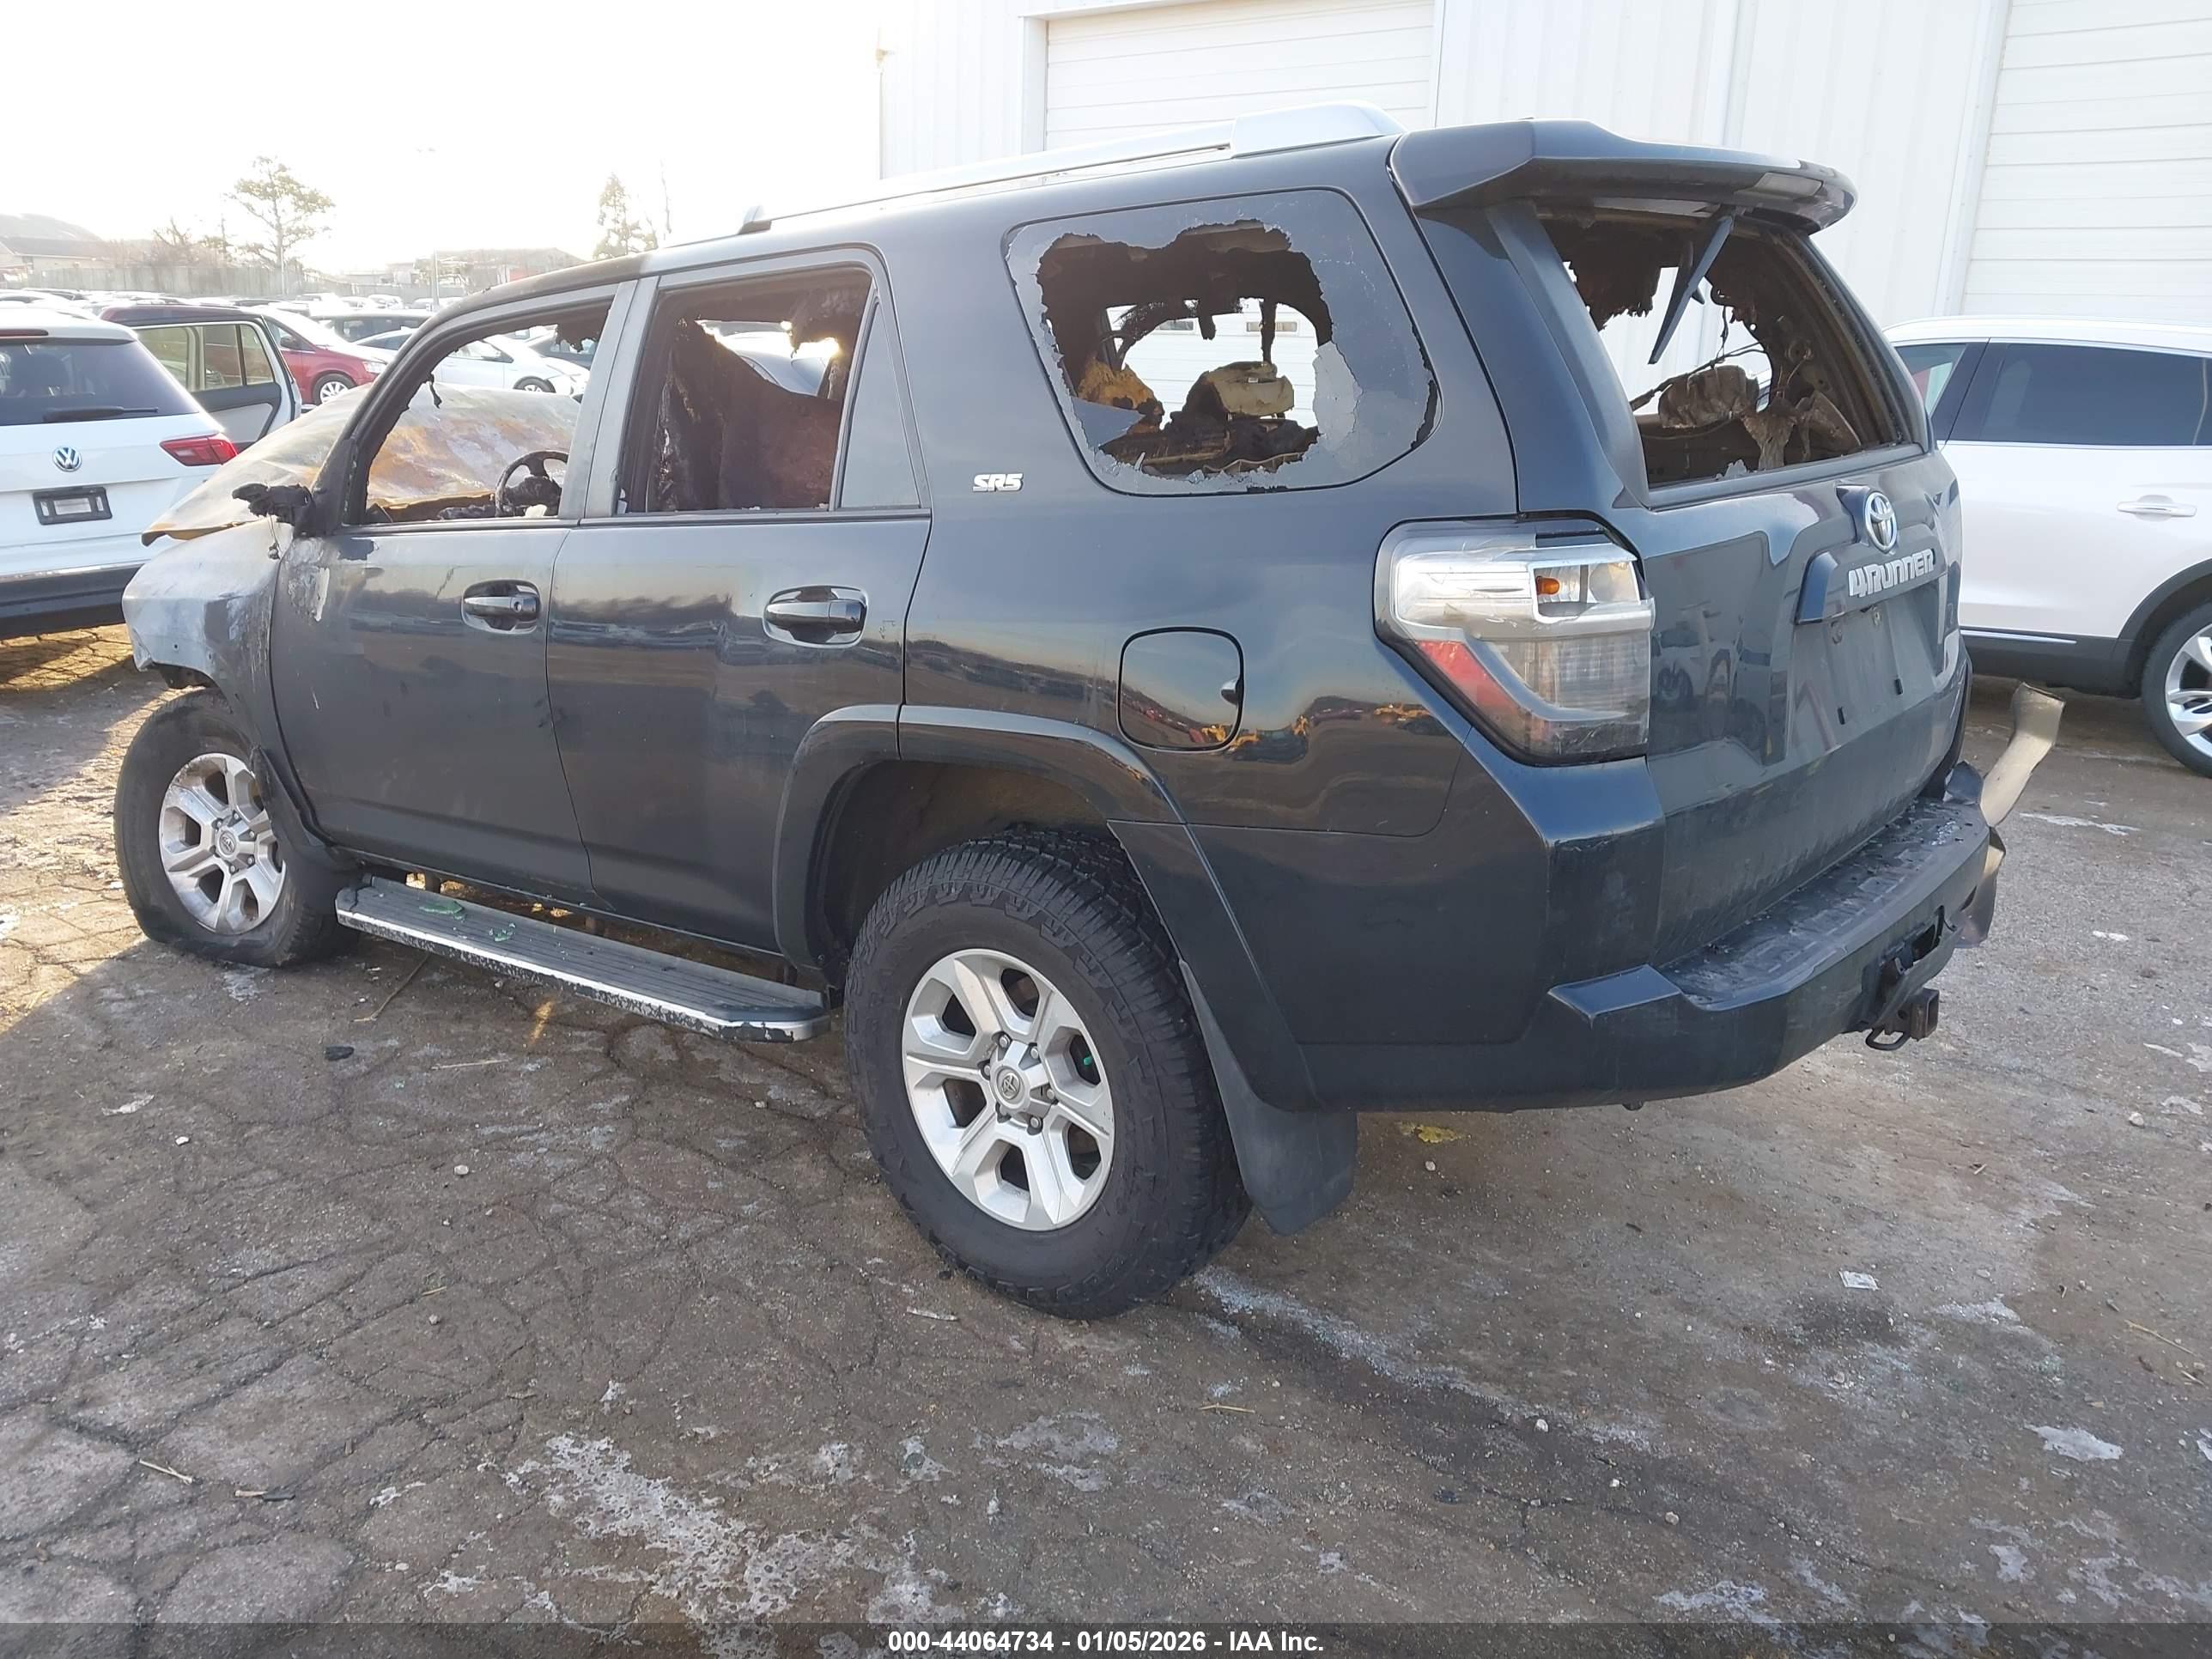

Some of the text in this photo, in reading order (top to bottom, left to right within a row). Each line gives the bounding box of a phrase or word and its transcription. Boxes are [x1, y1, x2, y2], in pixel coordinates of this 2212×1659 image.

[52, 446, 82, 472] VW
[972, 472, 1024, 492] SR5
[1848, 549, 1935, 598] 4RUNNER
